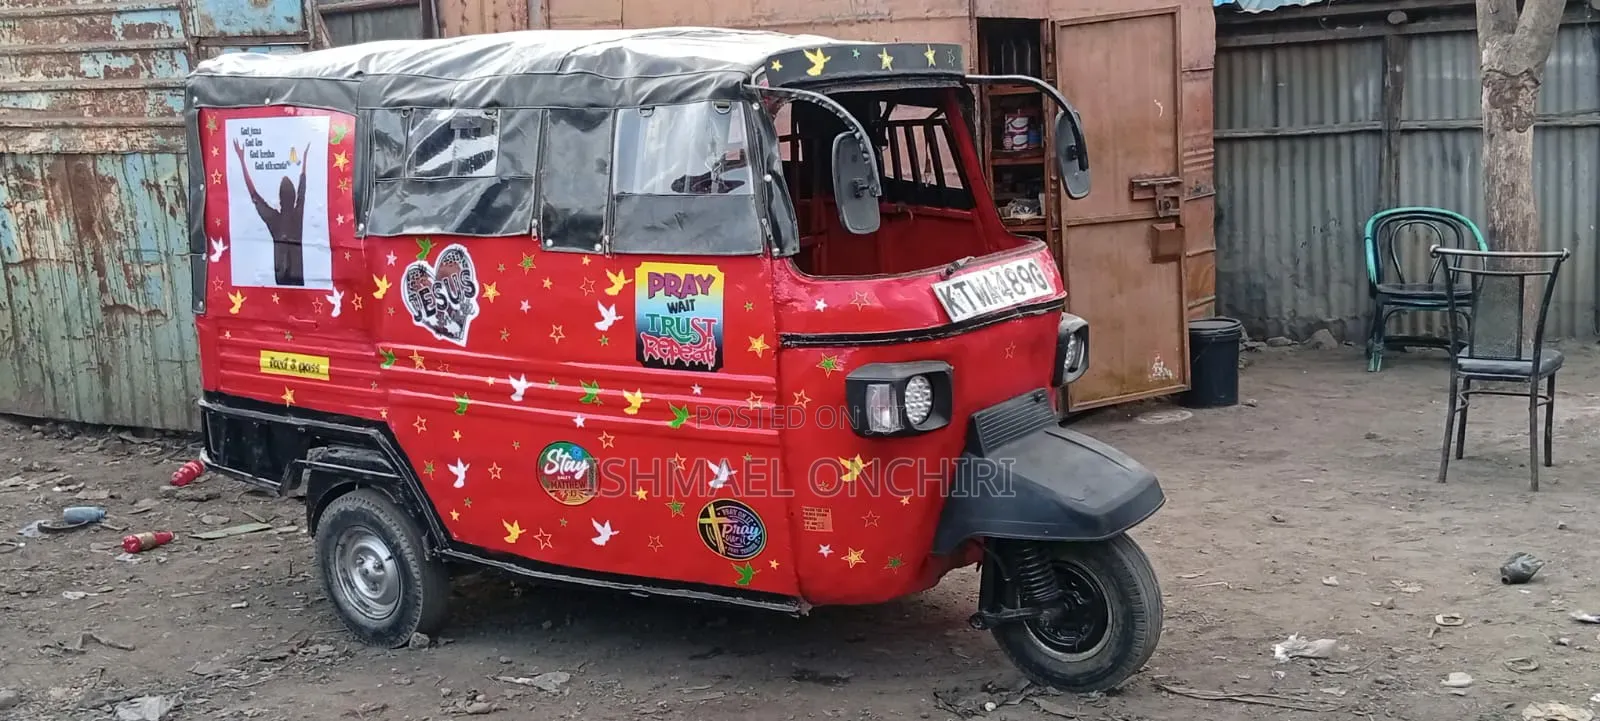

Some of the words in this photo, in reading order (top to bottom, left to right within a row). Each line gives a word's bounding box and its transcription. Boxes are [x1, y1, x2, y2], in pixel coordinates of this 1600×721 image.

[241, 127, 249, 135] God
[245, 138, 254, 146] God
[250, 150, 259, 158] God
[255, 161, 264, 170] God
[647, 271, 716, 299] PRAY
[409, 269, 475, 322] JESUS
[666, 299, 695, 314] WAIT
[645, 313, 718, 347] TRUST
[544, 447, 590, 480] Stay
